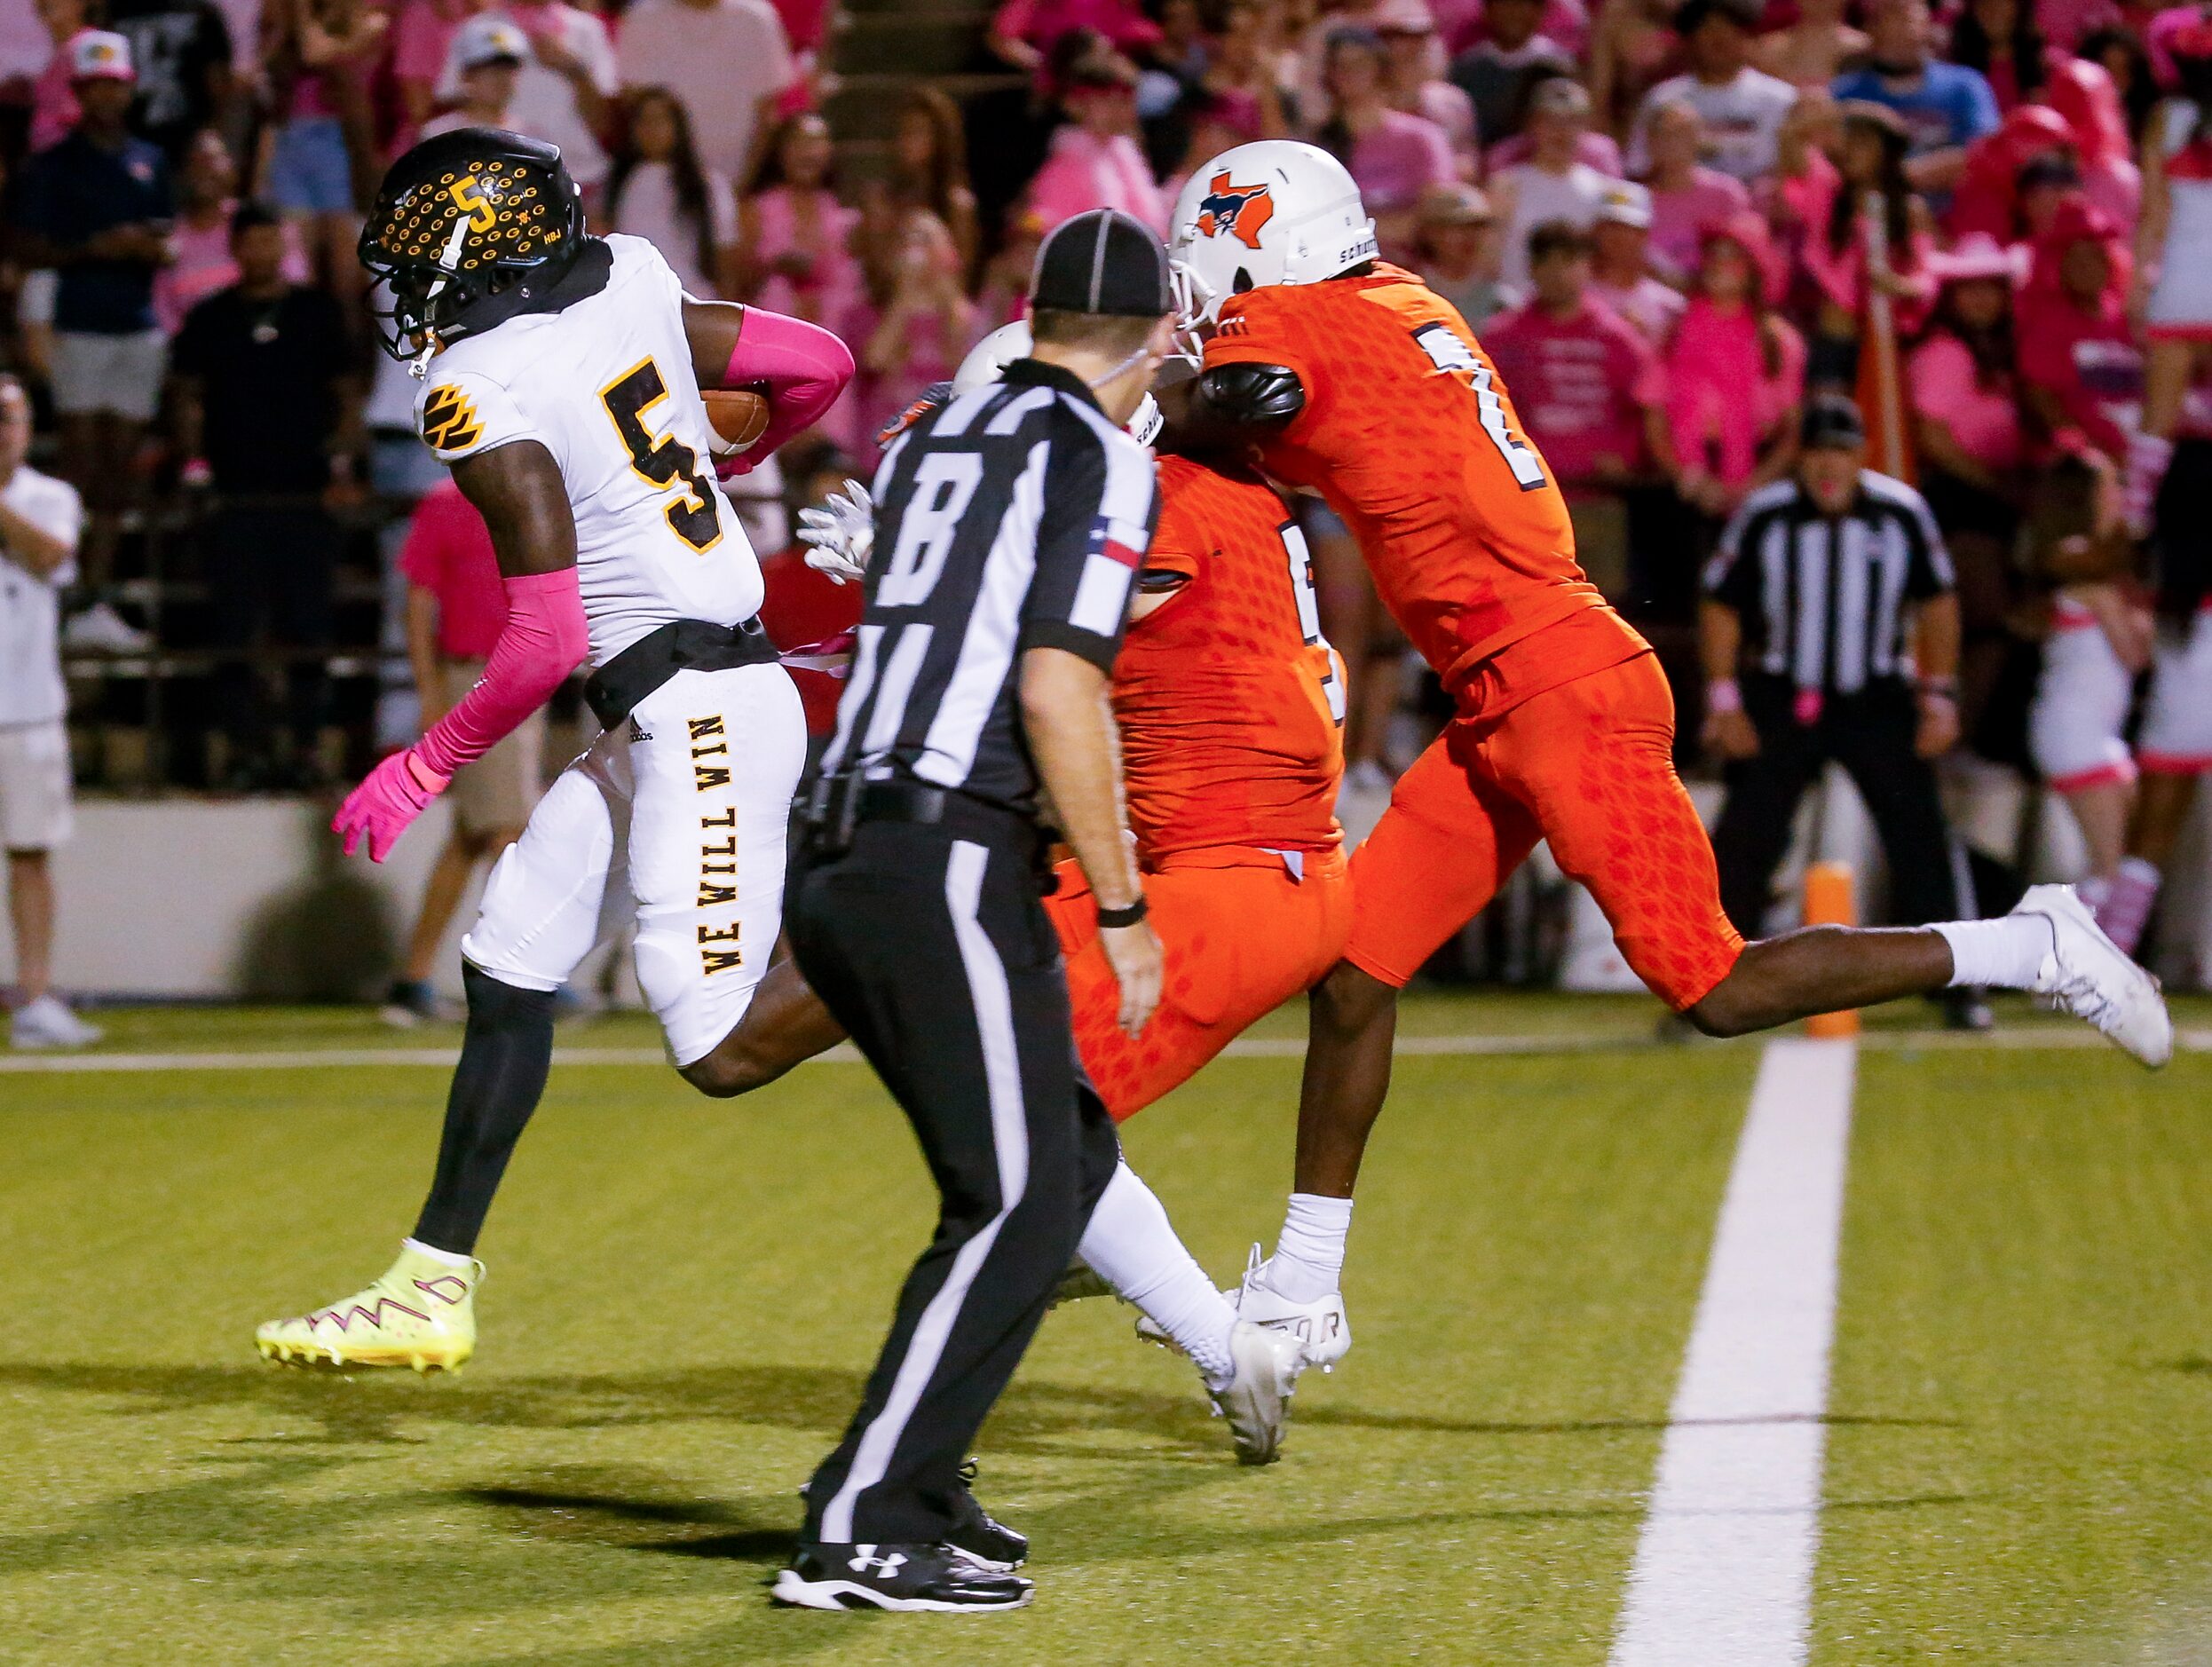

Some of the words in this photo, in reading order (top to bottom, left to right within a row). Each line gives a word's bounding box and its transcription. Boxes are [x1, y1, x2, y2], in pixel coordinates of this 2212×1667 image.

[448, 175, 496, 233] 5
[544, 228, 561, 244] HBJ
[596, 354, 724, 556] 5
[874, 452, 983, 607] B
[686, 714, 732, 793] WIN
[696, 806, 739, 908] WILL
[696, 920, 744, 977] WE
